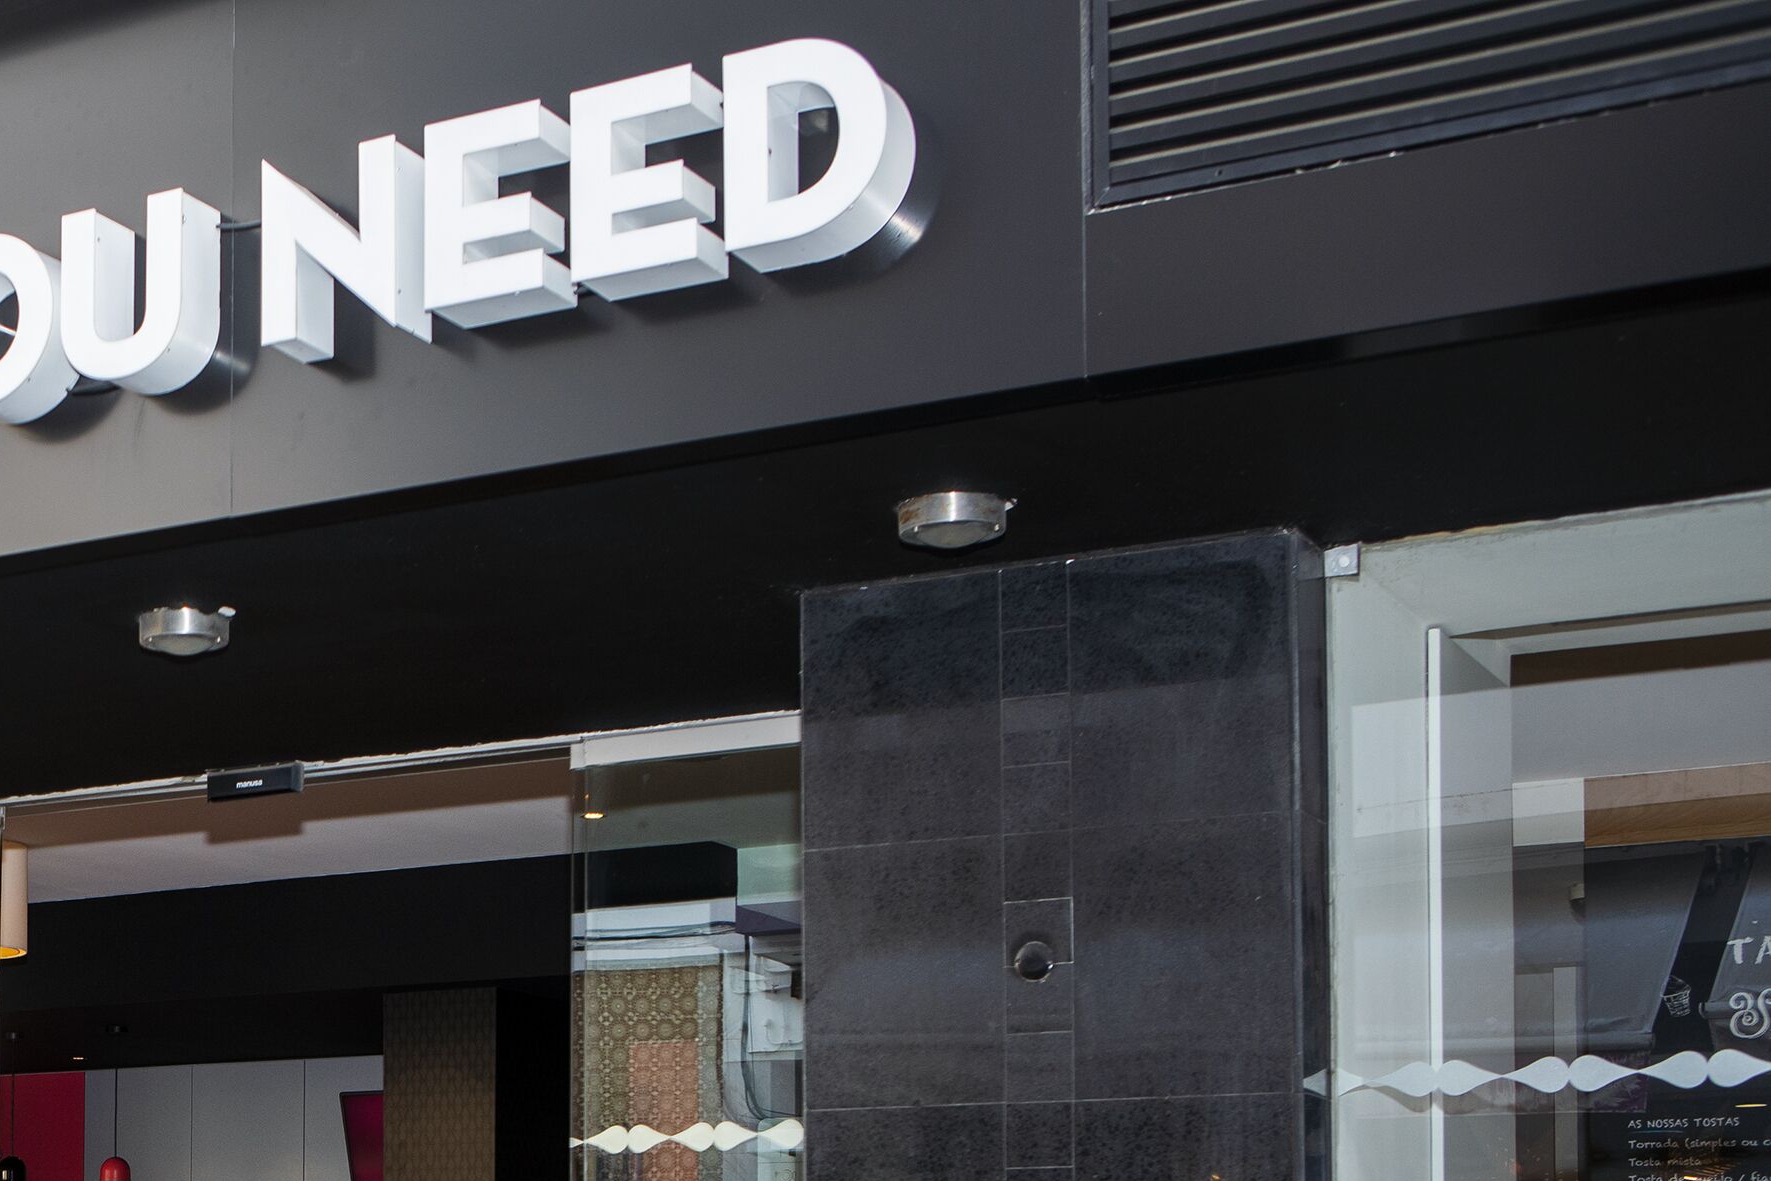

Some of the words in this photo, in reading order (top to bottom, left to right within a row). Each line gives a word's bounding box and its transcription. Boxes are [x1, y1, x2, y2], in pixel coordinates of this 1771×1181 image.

[261, 38, 915, 363] NEED
[1627, 1119, 1642, 1129] AS
[1647, 1118, 1689, 1128] NOSSAS
[1694, 1117, 1740, 1127] TOSTAS
[1628, 1138, 1679, 1149] Torrada
[1741, 1139, 1758, 1147] ou
[1628, 1158, 1662, 1167] Tosta
[1667, 1157, 1702, 1166] mista
